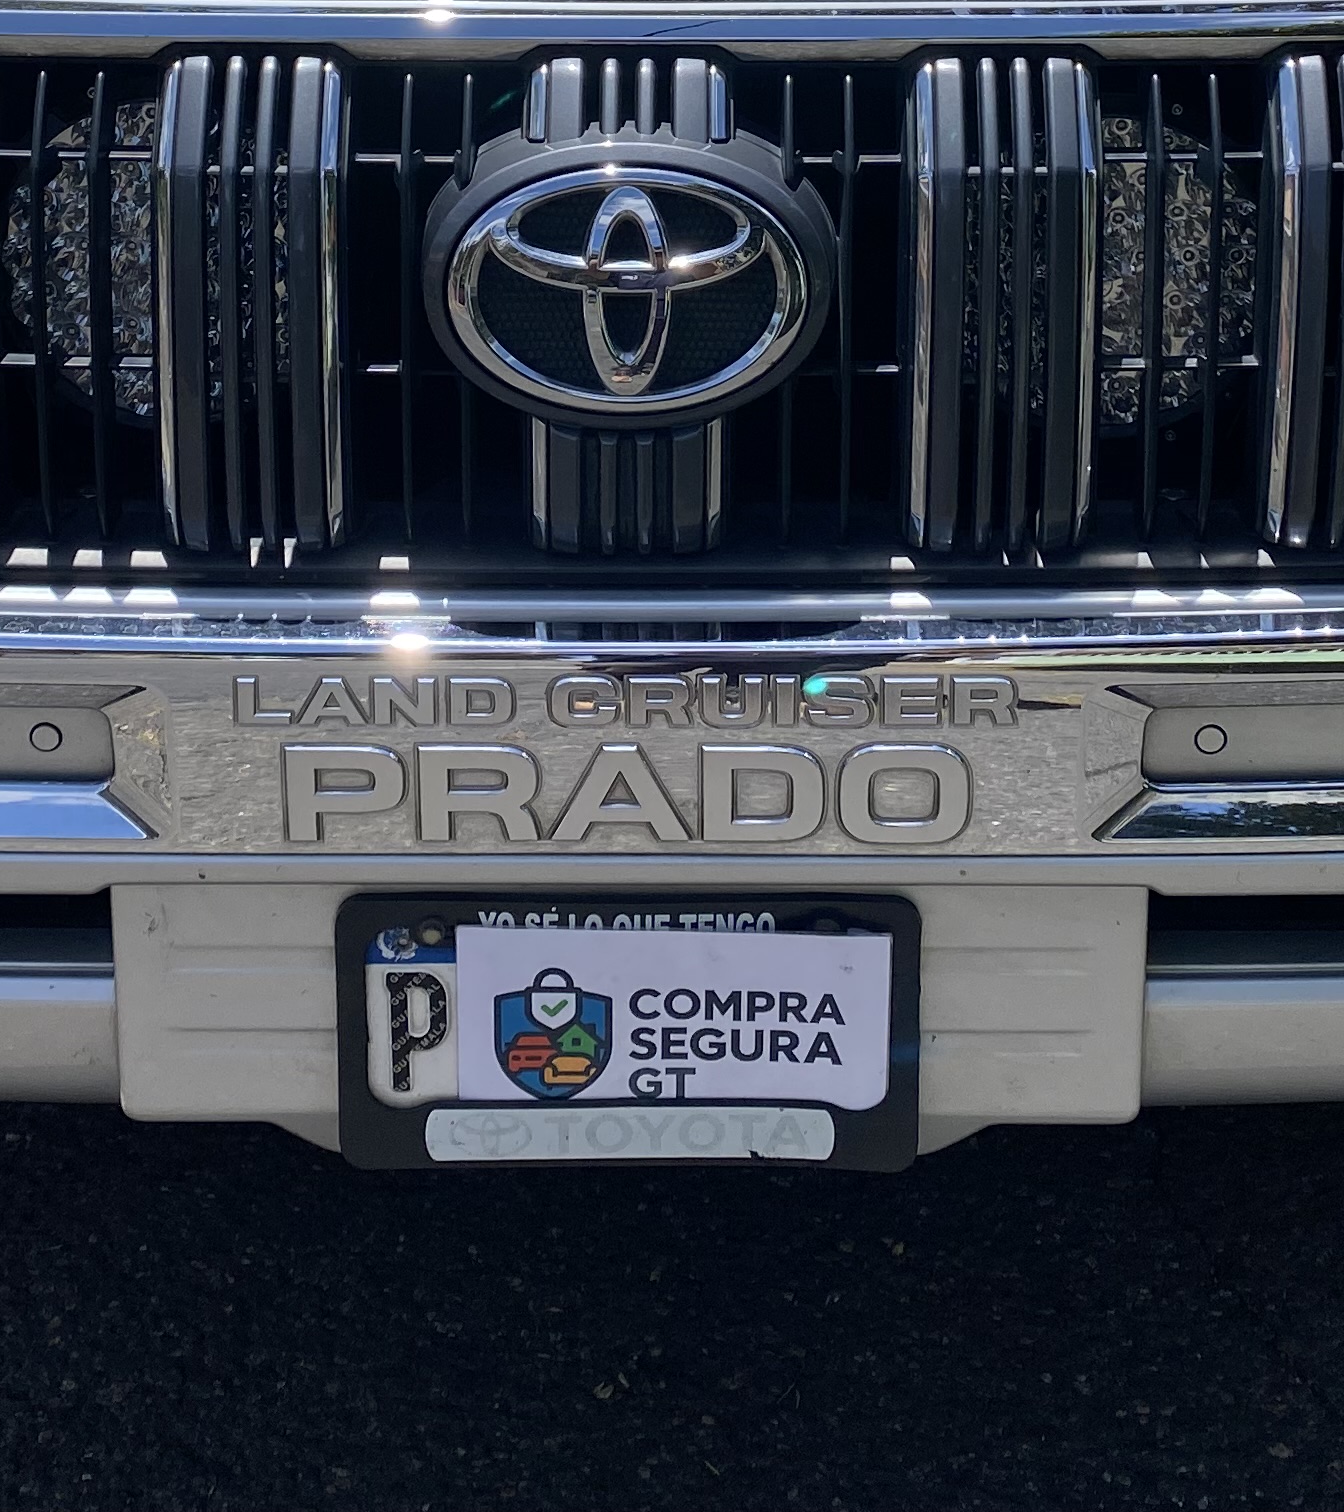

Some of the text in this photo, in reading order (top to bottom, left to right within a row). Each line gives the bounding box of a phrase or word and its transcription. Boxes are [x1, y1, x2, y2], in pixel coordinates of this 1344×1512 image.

[232, 672, 1019, 729] LAND CRUISER
[279, 741, 973, 844] PRADO
[628, 988, 846, 1026] COMPRA
[386, 972, 447, 1092] P
[628, 1026, 843, 1066] SEGURA
[628, 1067, 697, 1099] GT
[544, 1113, 809, 1155] TOYOTA
